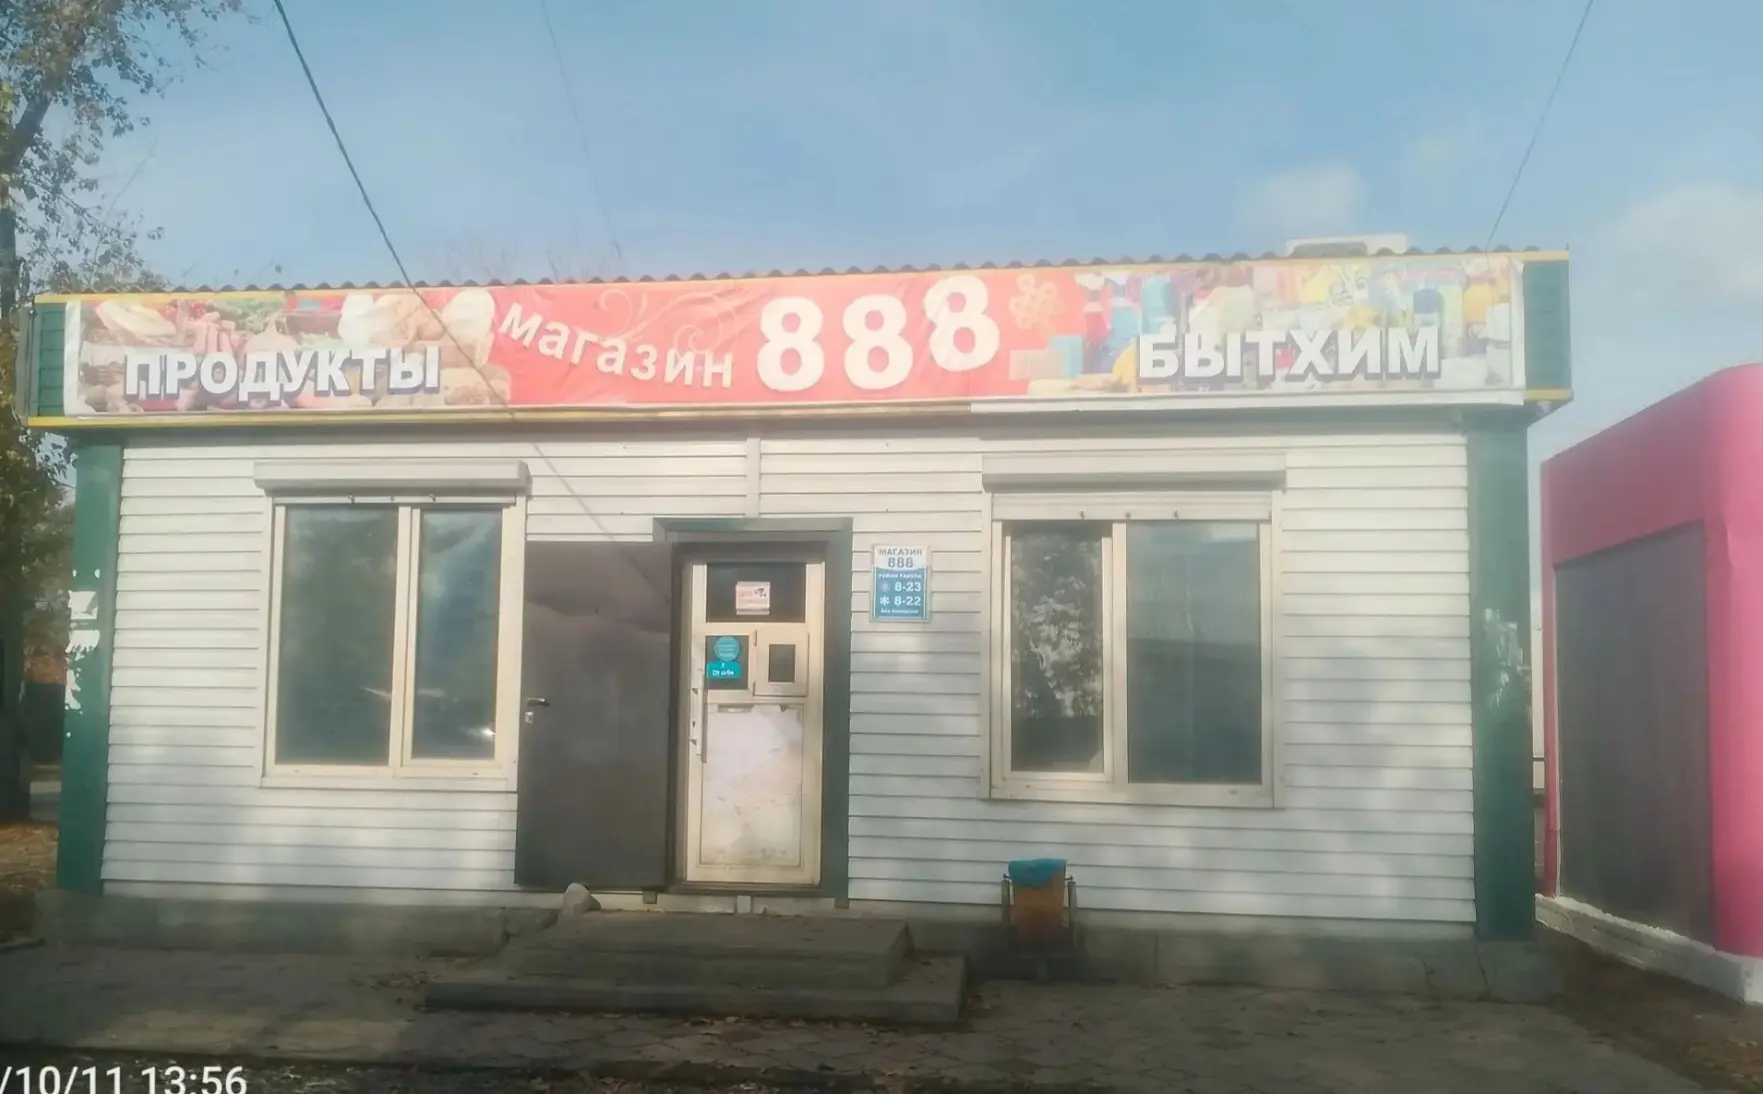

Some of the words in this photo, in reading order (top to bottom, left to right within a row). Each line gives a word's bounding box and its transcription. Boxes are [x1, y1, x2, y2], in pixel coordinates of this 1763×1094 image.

[500, 302, 734, 388] магазин
[756, 274, 1001, 391] 888
[1138, 326, 1441, 380] БЫТХИМ
[125, 346, 441, 401] ПРОДУКТЫ
[879, 548, 923, 556] МАГАЗИН
[888, 557, 914, 568] 888
[894, 581, 922, 592] 8-23
[894, 595, 922, 606] 8-22
